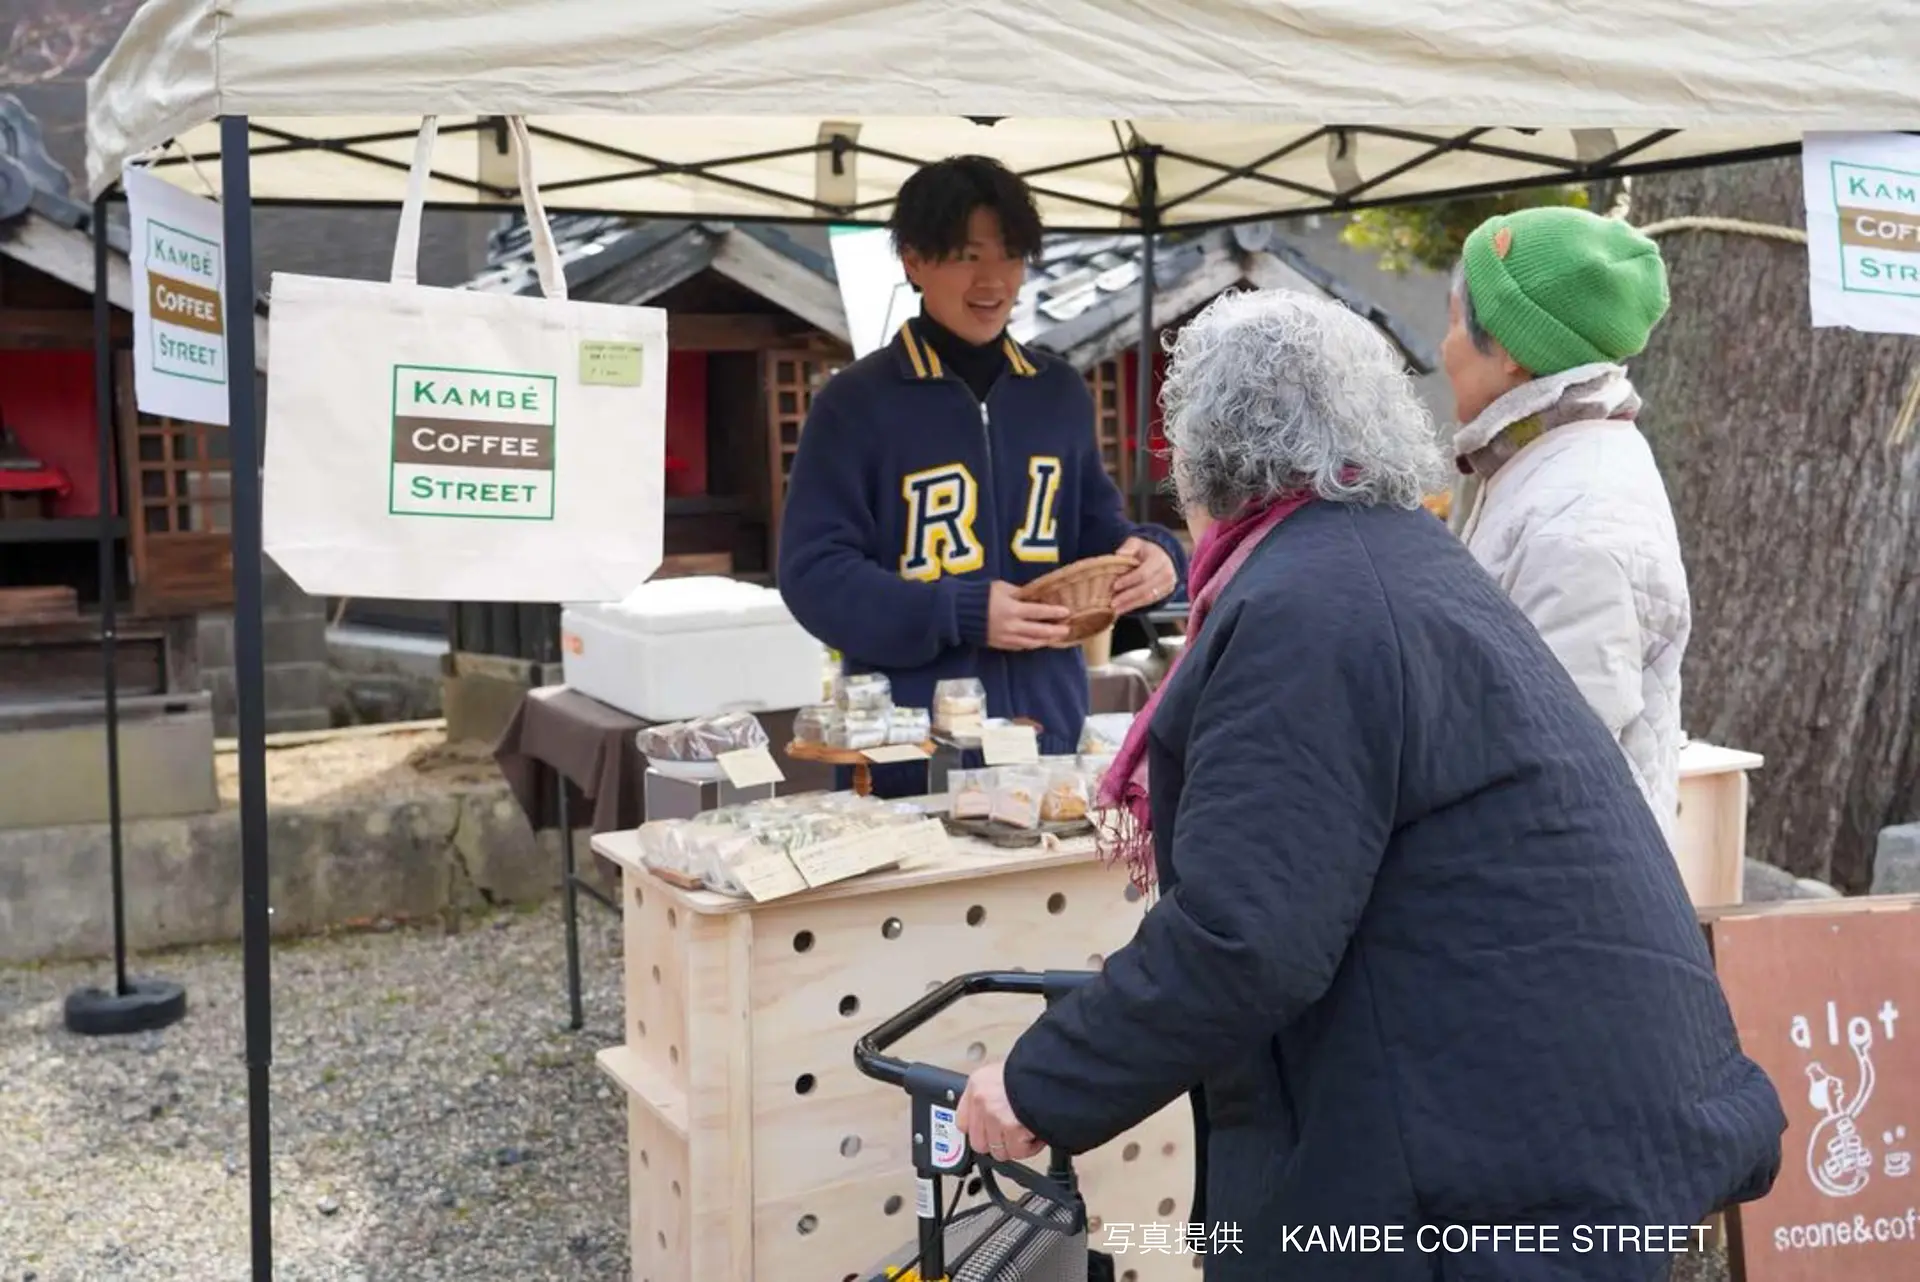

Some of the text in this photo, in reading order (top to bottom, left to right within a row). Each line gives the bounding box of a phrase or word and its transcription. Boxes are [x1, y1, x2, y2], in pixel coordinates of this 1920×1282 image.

[155, 284, 217, 322] COFFEE
[159, 332, 217, 366] STREET
[414, 380, 539, 411] KAMBÉ
[411, 427, 539, 457] COFFEE
[411, 475, 537, 503] STREET
[900, 456, 1061, 583] R L
[1774, 1207, 1920, 1251] scone&cof
